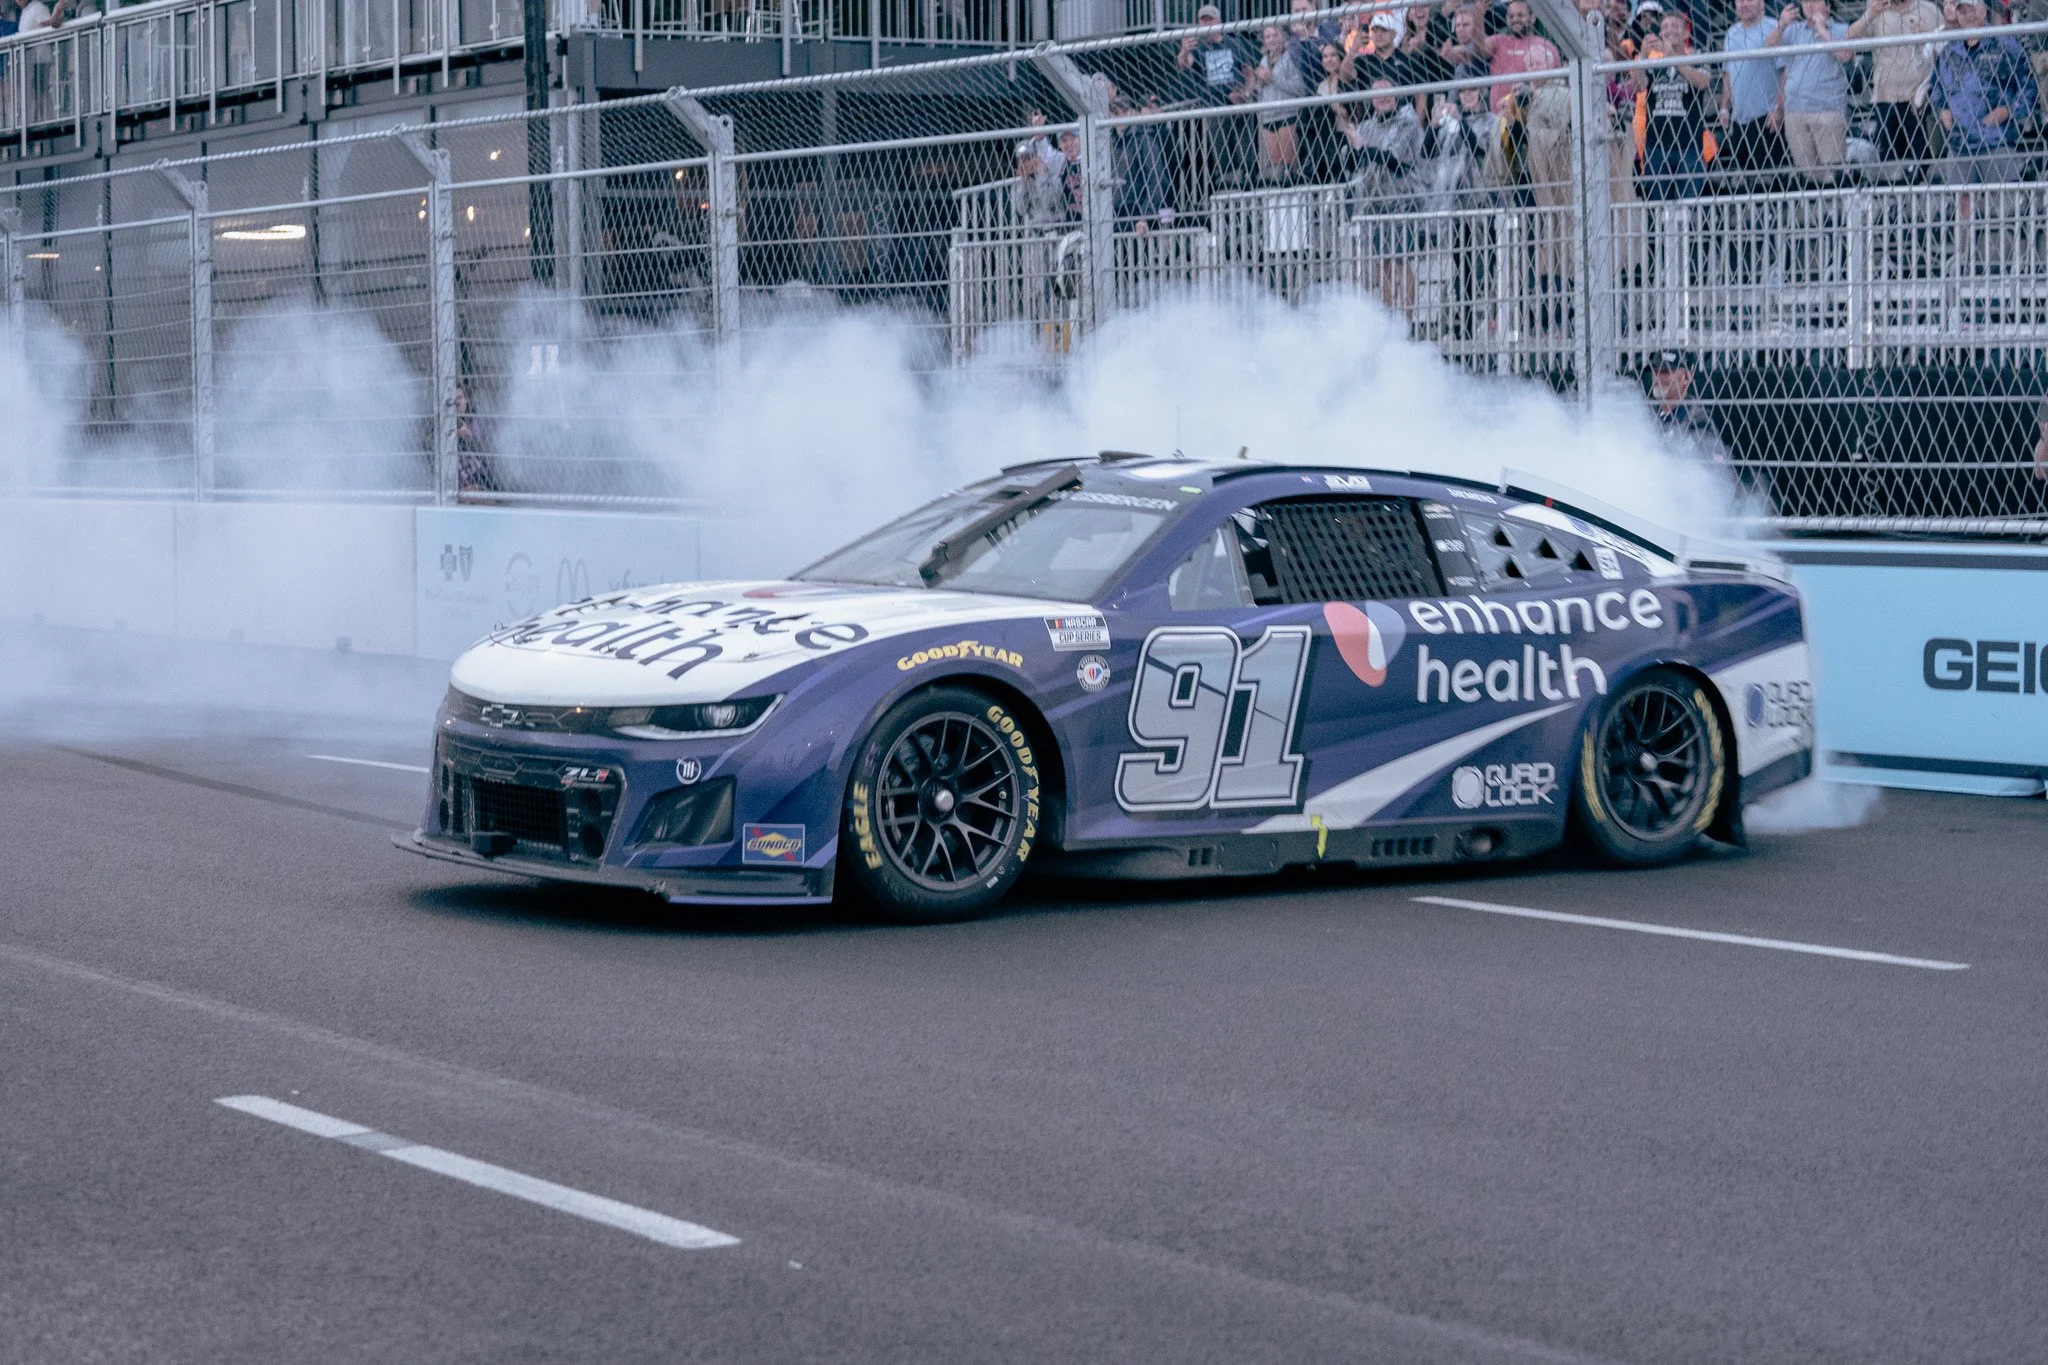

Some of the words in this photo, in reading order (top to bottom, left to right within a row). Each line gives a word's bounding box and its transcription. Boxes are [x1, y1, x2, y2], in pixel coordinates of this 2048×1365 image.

[1065, 616, 1097, 629] NASCAR
[1408, 588, 1664, 636] enhance
[1059, 630, 1075, 644] CUP
[1076, 629, 1102, 643] SERIES
[897, 640, 1024, 671] GOODYEAR
[1923, 637, 2048, 694] GEI
[1416, 644, 1608, 703] health
[1115, 624, 1312, 814] 91
[986, 705, 1040, 862] GOODYEAR
[1485, 762, 1556, 786] QUAD
[1485, 783, 1560, 808] LOCK
[746, 838, 802, 850] SUNOCO
